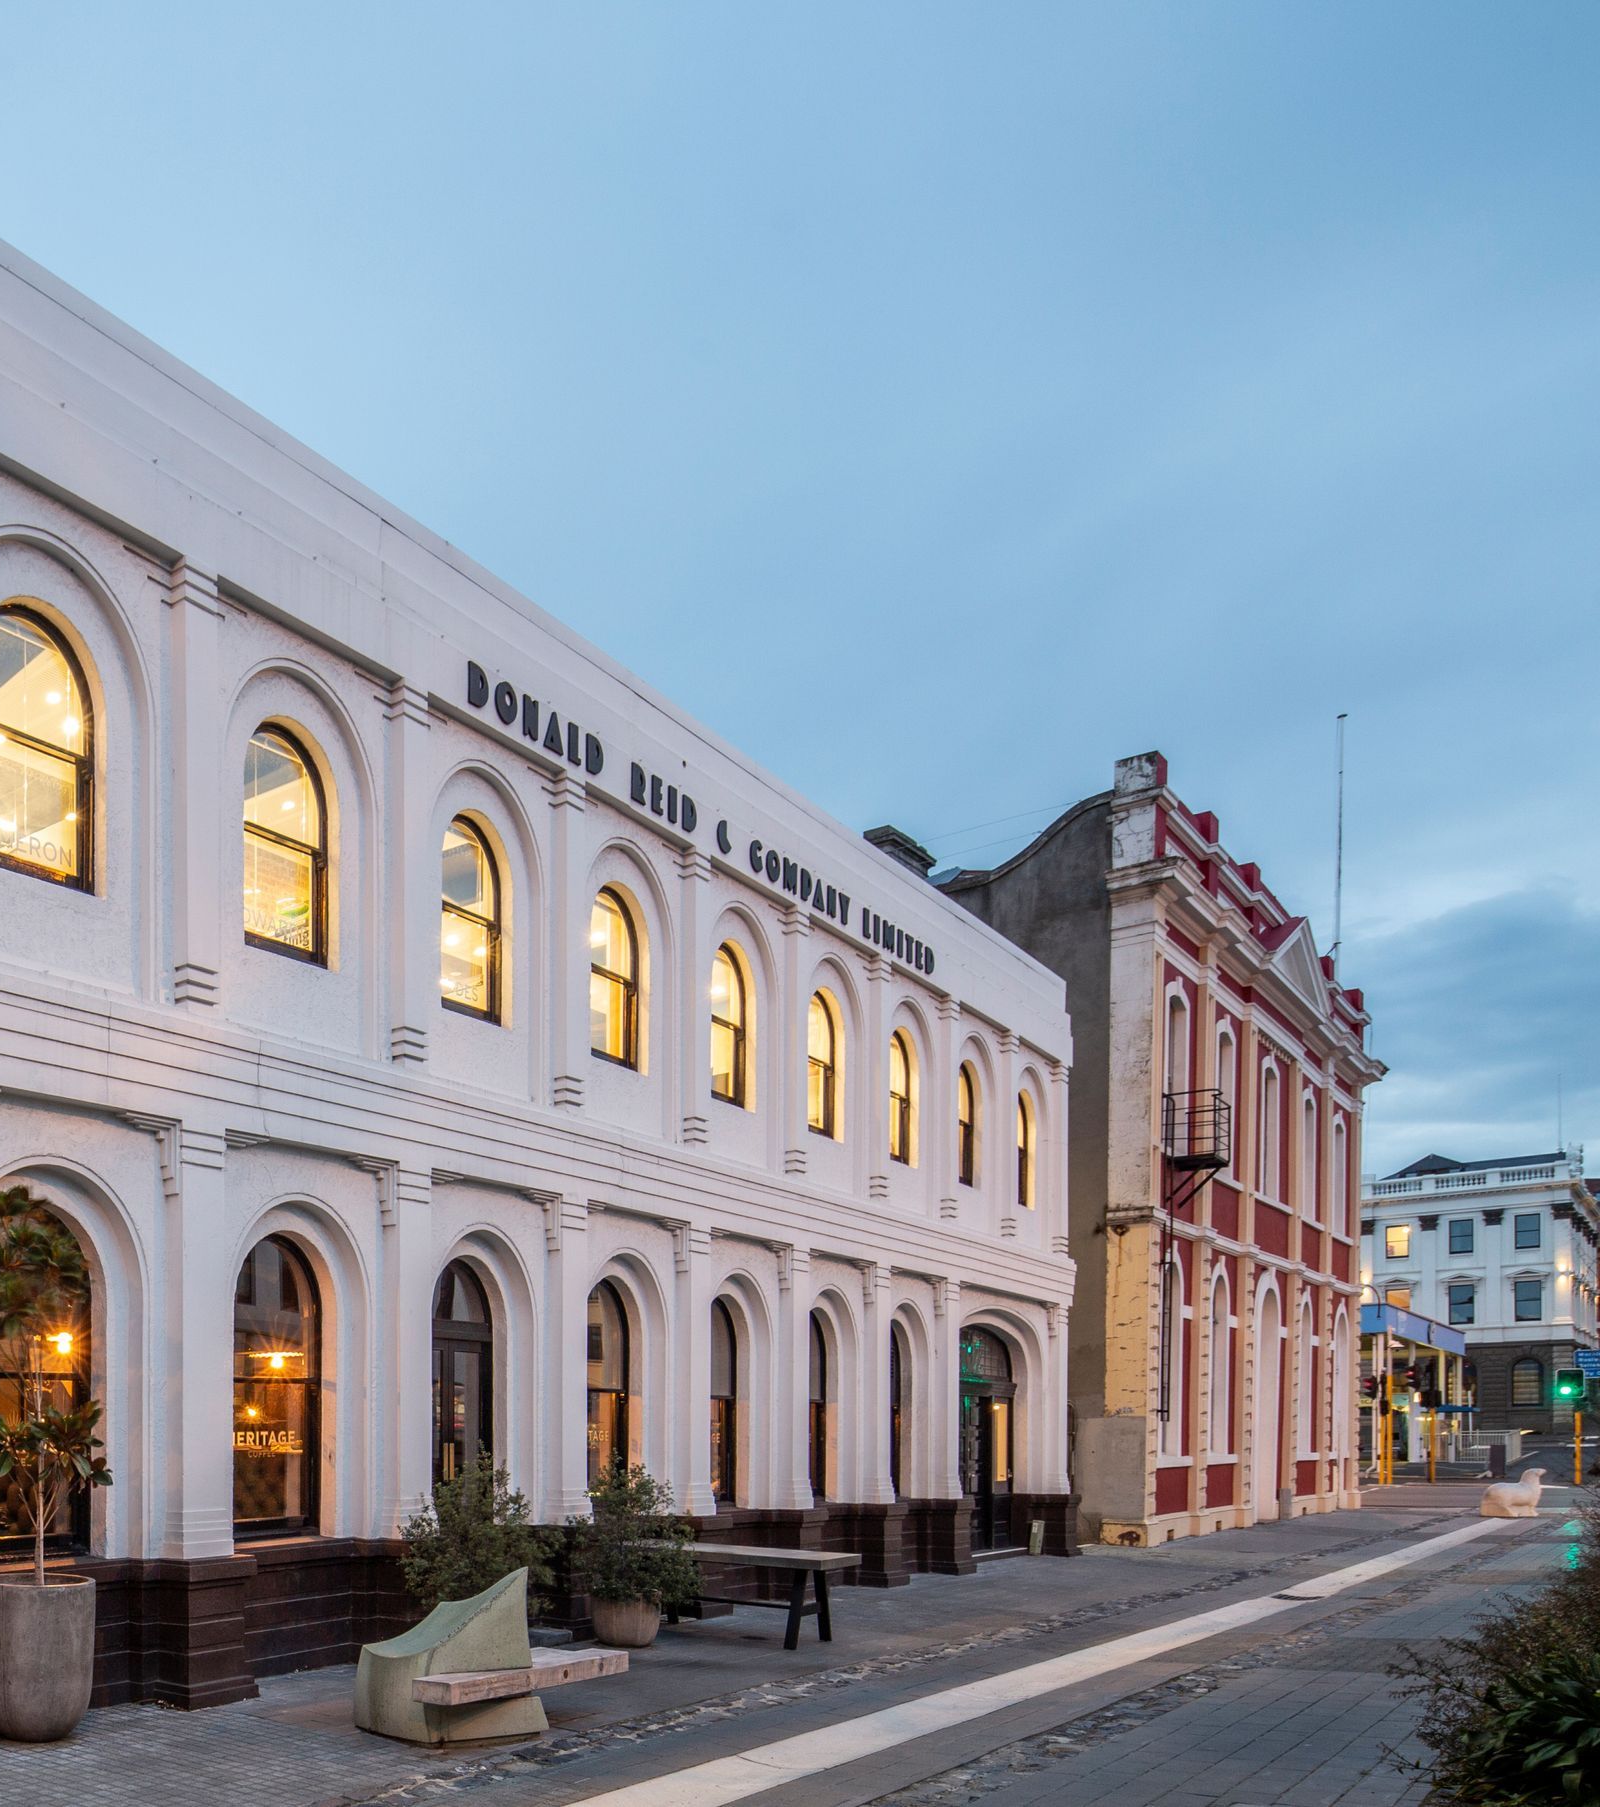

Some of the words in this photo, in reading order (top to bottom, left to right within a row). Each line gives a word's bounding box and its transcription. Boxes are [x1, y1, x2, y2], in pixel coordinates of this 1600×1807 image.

[467, 660, 603, 775] DONALD
[630, 761, 697, 833] REID
[749, 839, 852, 926] COMPANY
[862, 907, 936, 975] LIMITED
